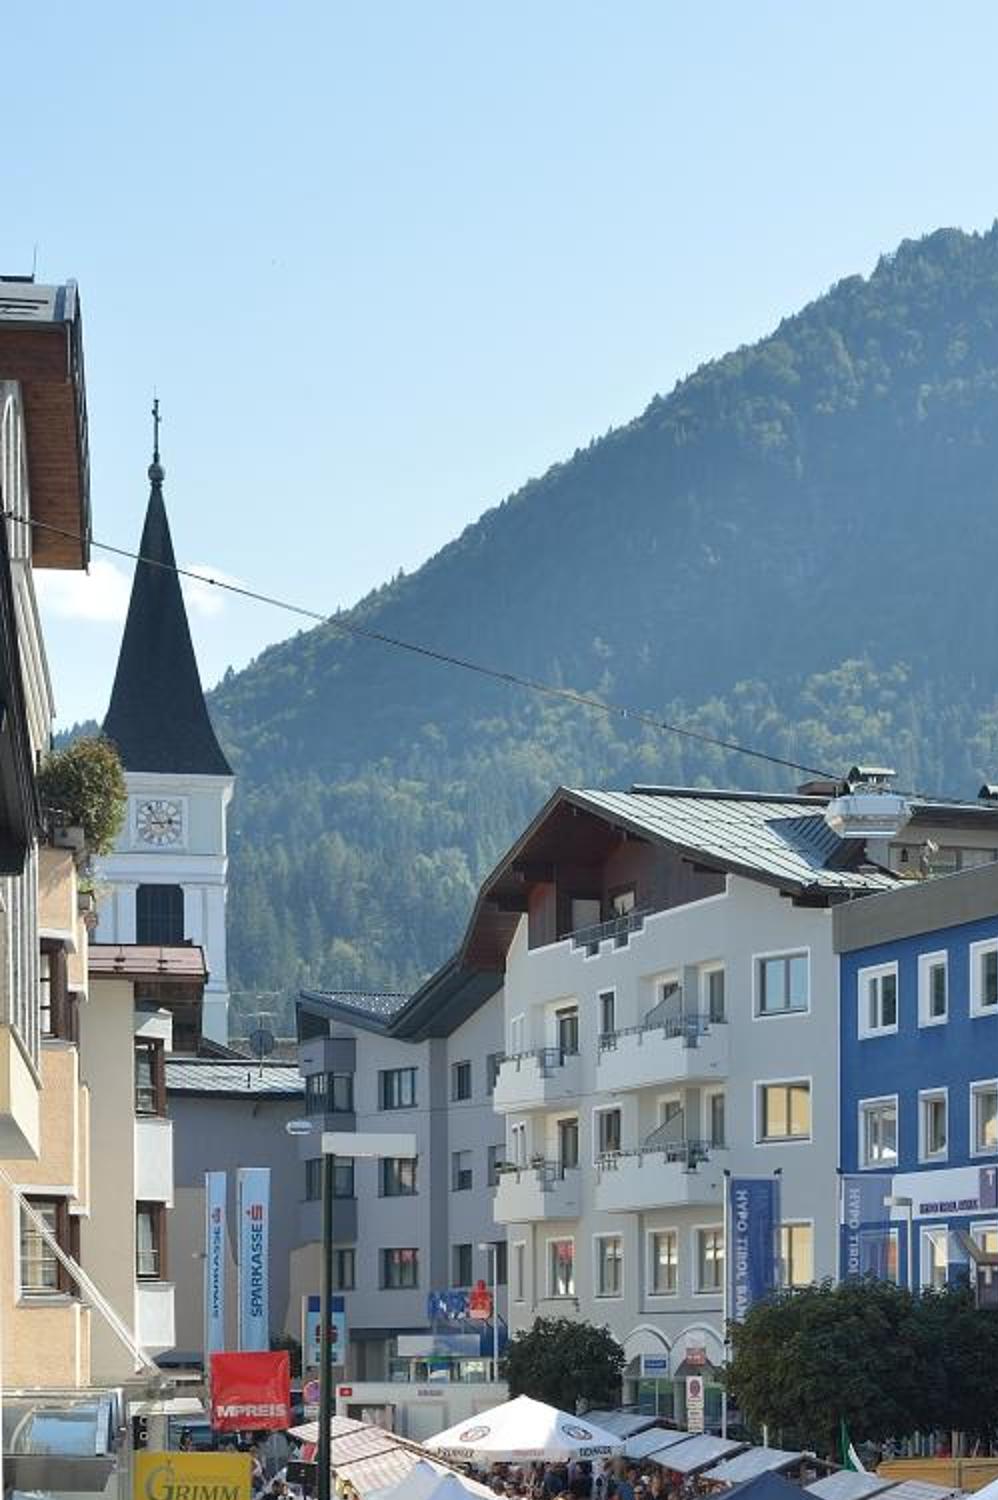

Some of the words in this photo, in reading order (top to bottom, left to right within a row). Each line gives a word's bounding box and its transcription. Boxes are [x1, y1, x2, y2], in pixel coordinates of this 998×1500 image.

[735, 1189, 749, 1231] HYPO
[848, 1188, 861, 1229] HYPO
[251, 1223, 264, 1318] SPARKASSE
[735, 1235, 749, 1280] TIROL
[215, 1403, 287, 1418] MPREIS
